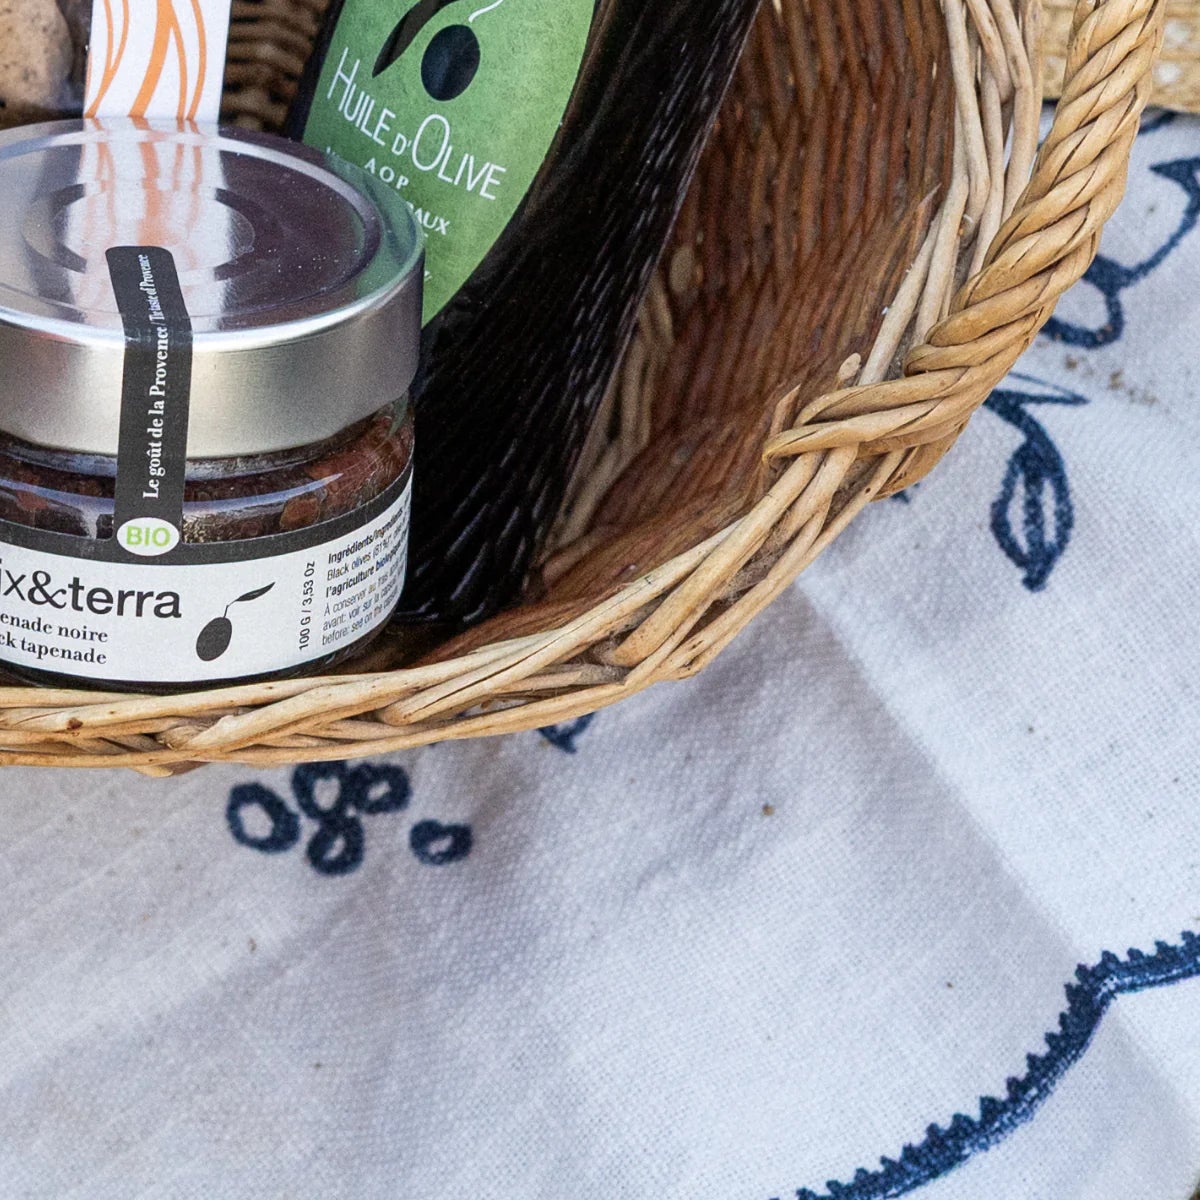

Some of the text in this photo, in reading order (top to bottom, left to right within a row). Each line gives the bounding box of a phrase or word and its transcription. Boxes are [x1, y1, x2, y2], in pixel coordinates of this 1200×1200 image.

[327, 47, 396, 146] HUILE
[149, 326, 169, 397] Provence
[148, 400, 165, 416] la
[147, 418, 164, 439] de
[146, 441, 165, 477] goût
[143, 479, 159, 499] Le
[125, 526, 172, 547] BIO
[327, 566, 349, 581] Black
[351, 554, 371, 570] olives
[302, 580, 314, 606] 3,53
[326, 566, 374, 597] l'agriculture
[332, 588, 366, 612] conserver
[363, 599, 373, 611] sur
[301, 616, 311, 626] G
[322, 626, 349, 645] before:
[351, 618, 363, 633] see
[364, 613, 373, 625] on
[58, 625, 109, 643] noire
[299, 629, 310, 650] 100
[21, 637, 107, 665] tapenade
